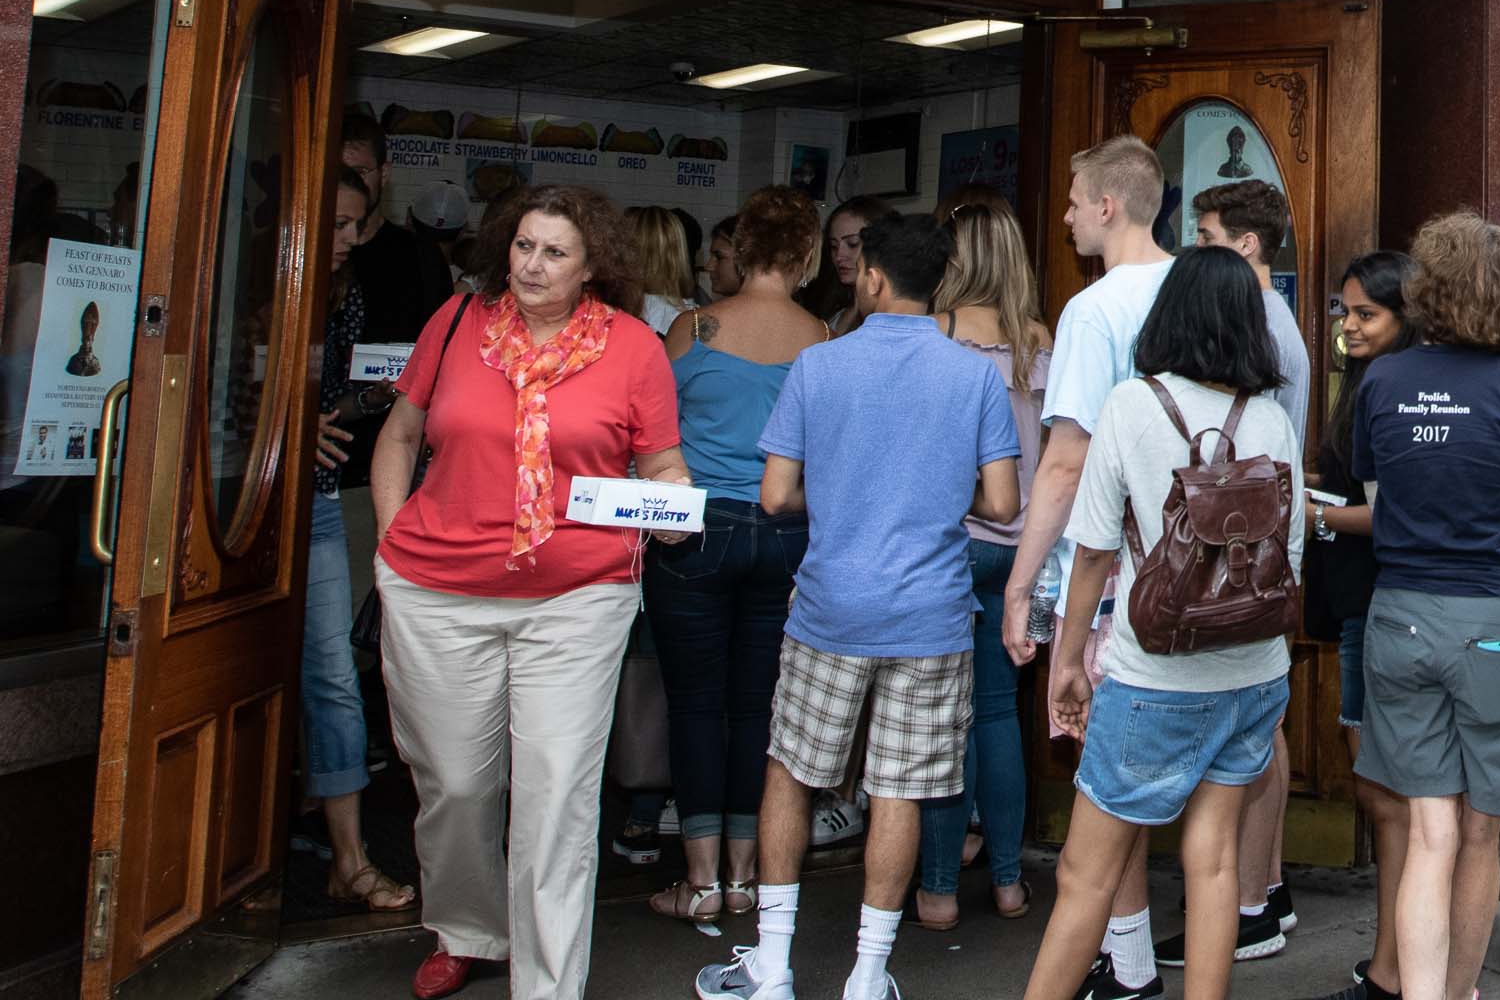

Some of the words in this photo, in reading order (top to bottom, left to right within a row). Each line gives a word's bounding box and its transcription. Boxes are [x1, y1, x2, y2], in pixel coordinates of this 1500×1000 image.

[38, 110, 125, 130] FLORENTINE
[384, 138, 450, 154] CHOCOLATE
[455, 144, 528, 162] STRAWBERRY
[391, 152, 440, 168] RICOTTA
[531, 151, 597, 166] LIMONCELLO
[618, 156, 647, 170] OREO
[677, 161, 716, 176] PEANUT
[677, 174, 716, 188] BUTTER
[64, 248, 89, 261] FEAST
[91, 252, 102, 262] OF
[104, 253, 132, 266] FEASTS
[68, 264, 84, 274] SAN
[85, 266, 125, 279] GENNARO
[56, 276, 85, 289] COMES
[87, 279, 98, 290] TO
[99, 281, 133, 294] BOSTON
[1417, 391, 1451, 402] Frolich
[1398, 403, 1429, 416] Family
[1430, 404, 1471, 415] Reunion
[1412, 425, 1450, 443] 2017
[651, 510, 690, 523] PASTRY
